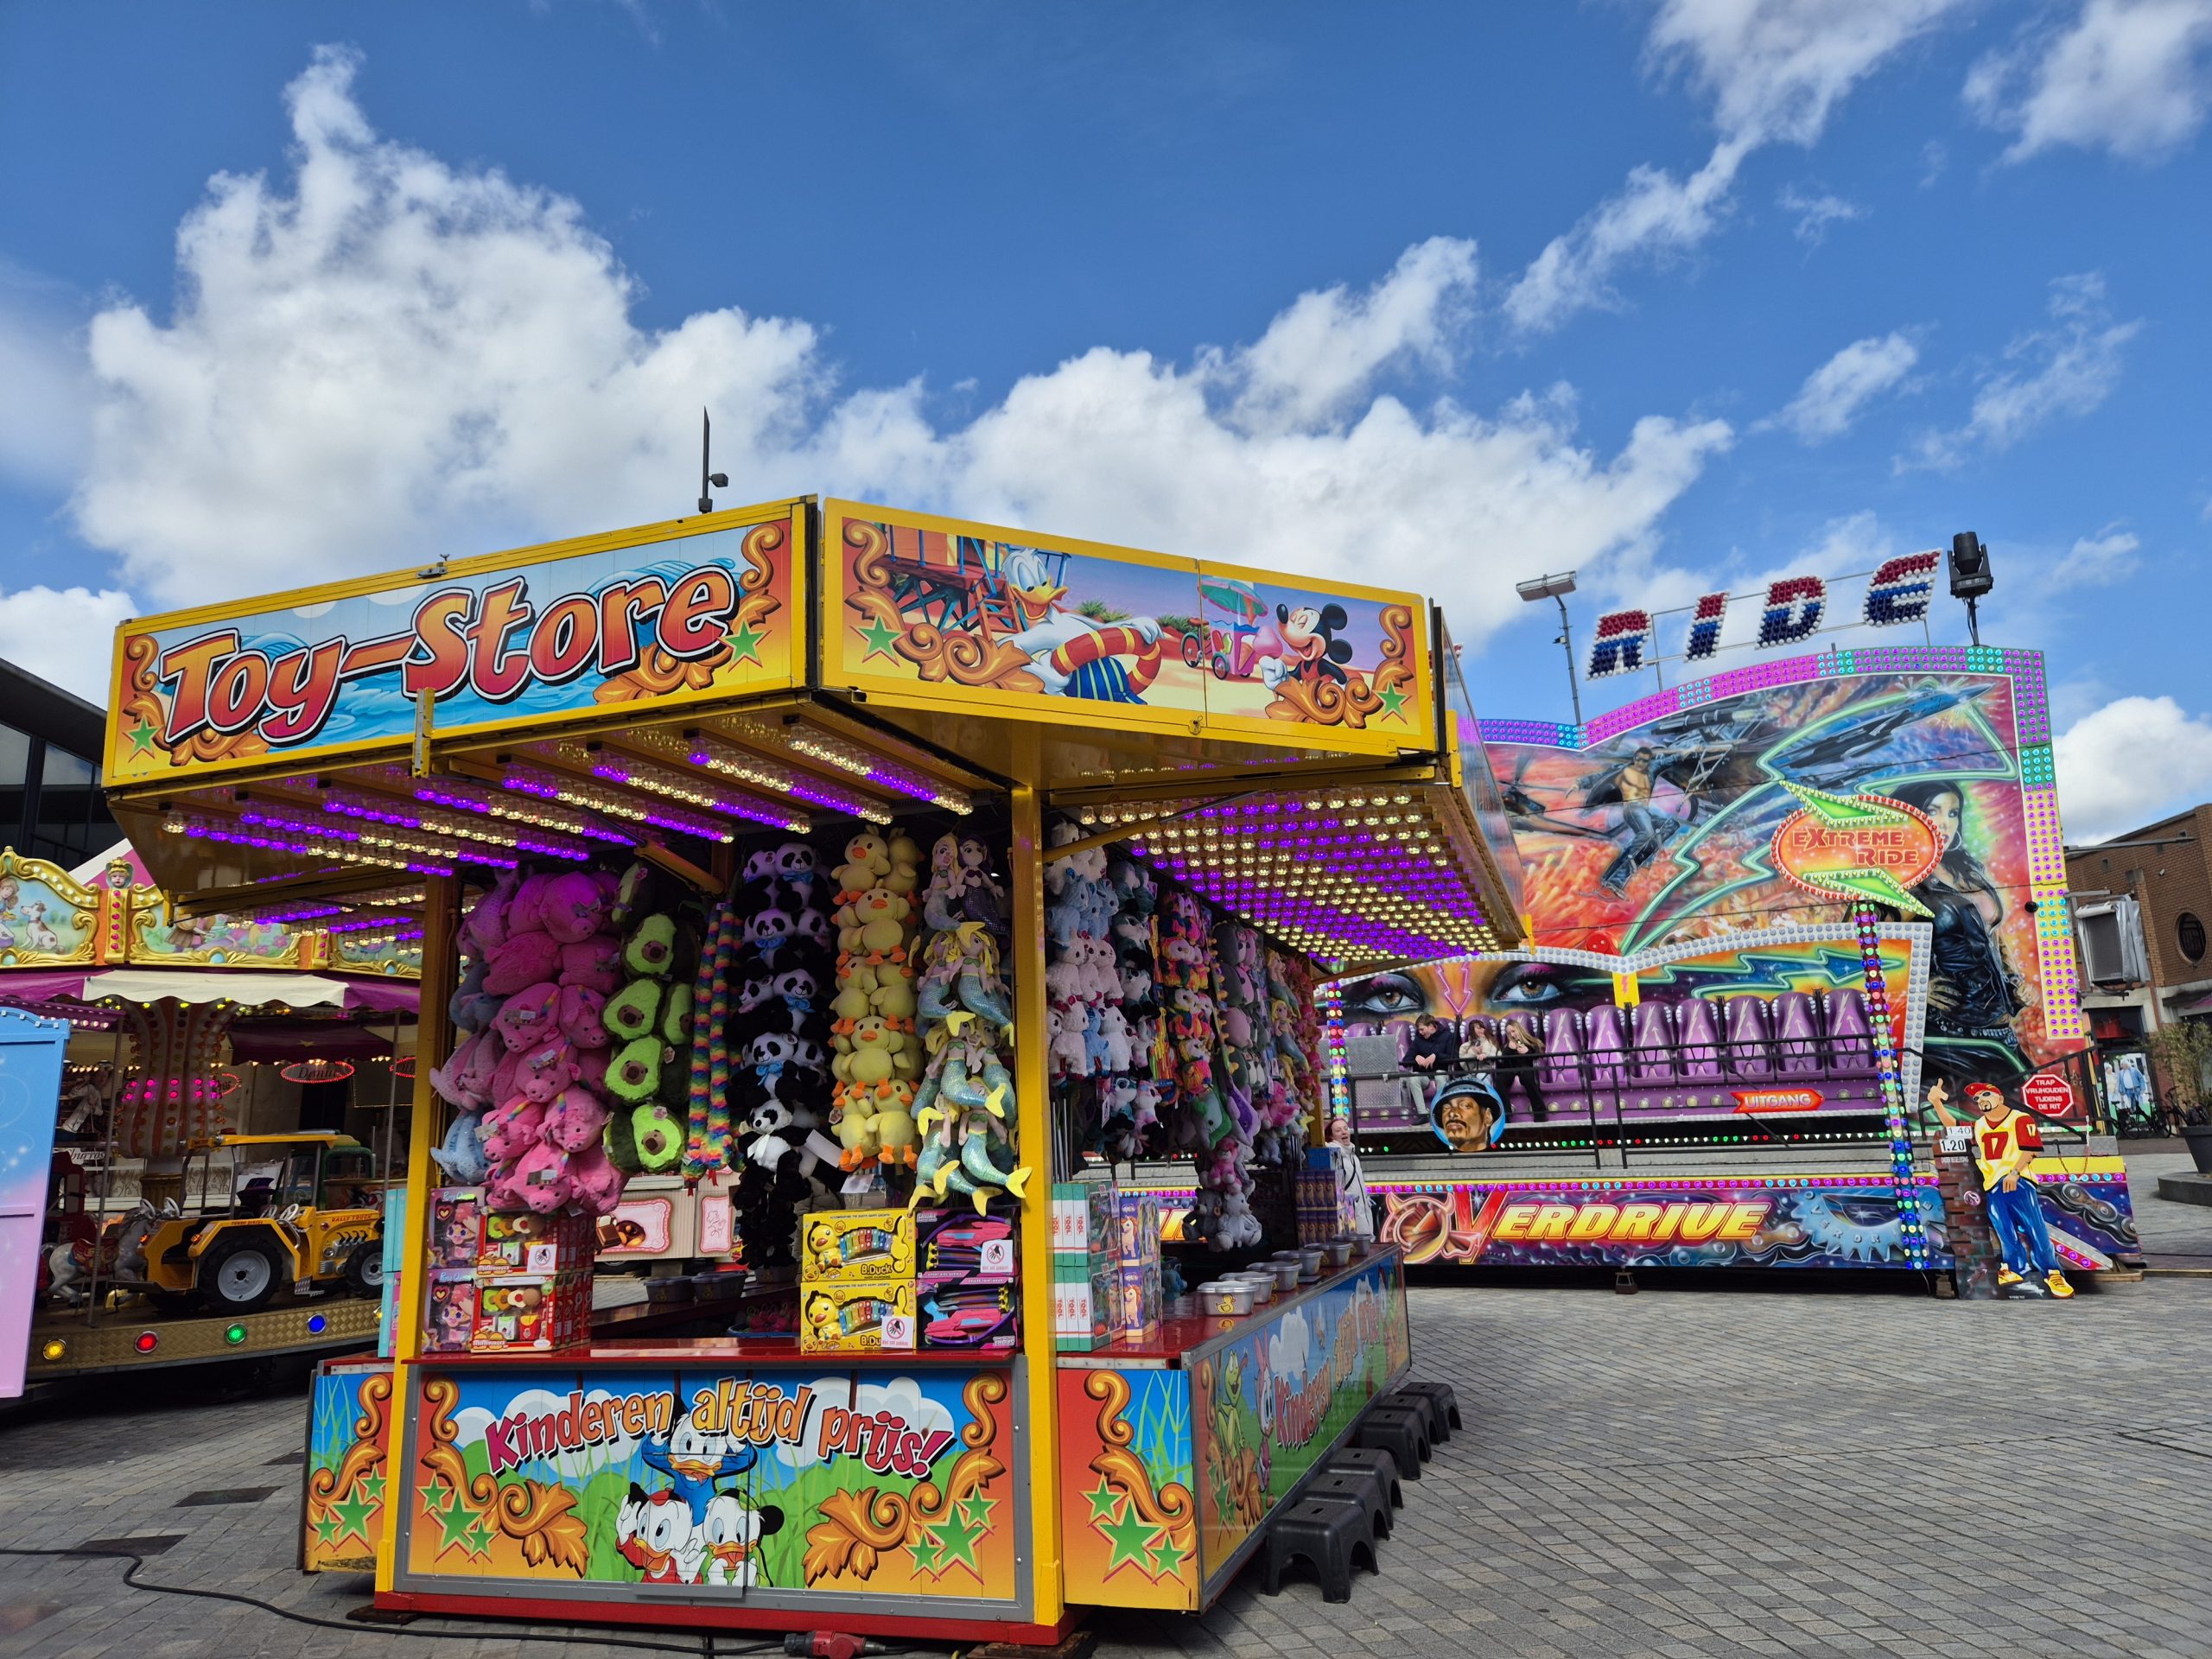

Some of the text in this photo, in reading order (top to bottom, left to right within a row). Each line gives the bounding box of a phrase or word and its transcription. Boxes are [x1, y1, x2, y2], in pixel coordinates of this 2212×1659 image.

[1586, 548, 1942, 681] RIDE
[160, 564, 739, 746] Toy-Store
[1793, 828, 1904, 851] EXTREME
[1856, 848, 1919, 867] RIDE
[1745, 1093, 1811, 1108] UITGANG
[1948, 1126, 1971, 1135] 1.40
[2026, 1123, 2037, 1137] 17
[1942, 1140, 1965, 1151] 1.20
[1980, 1131, 2009, 1160] 17
[861, 1263, 893, 1275] B.Duck
[861, 1334, 881, 1346] B.Du
[1273, 1357, 1332, 1452] Kinderen
[486, 1376, 956, 1479] Kinderen altijd prijs!
